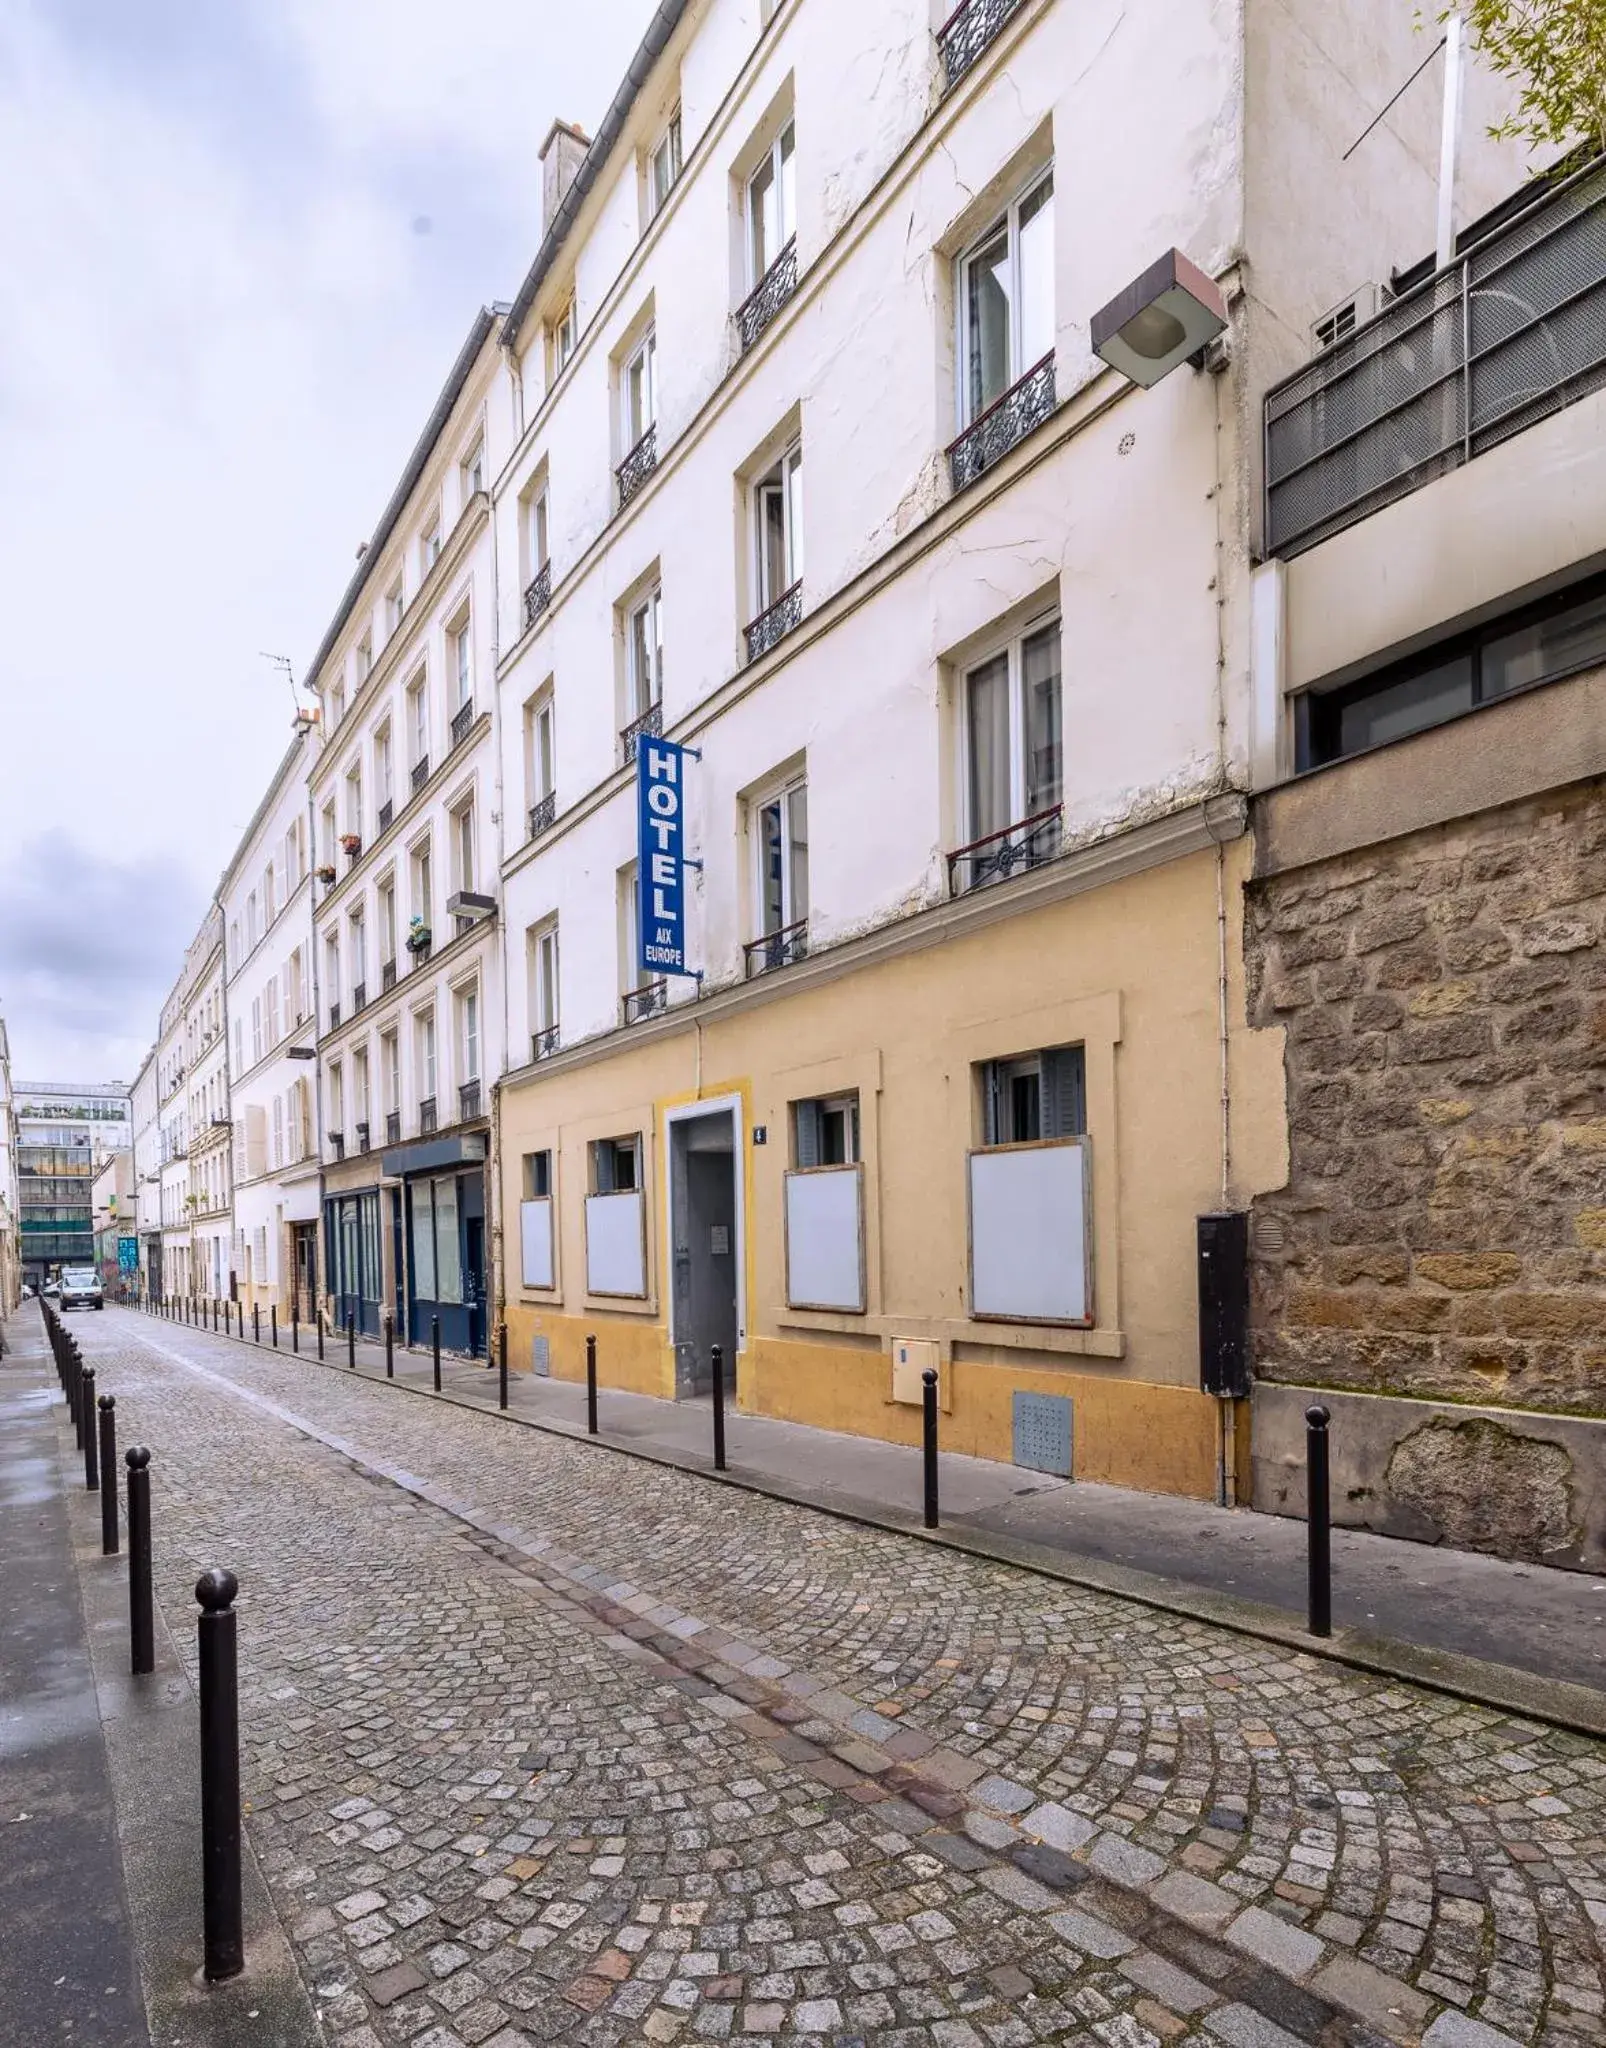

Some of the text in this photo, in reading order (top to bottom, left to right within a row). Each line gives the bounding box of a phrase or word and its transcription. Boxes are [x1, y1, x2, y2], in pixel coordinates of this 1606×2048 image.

[648, 747, 678, 921] HOTEL
[656, 927, 672, 945] AIX
[645, 944, 682, 966] EUROPE
